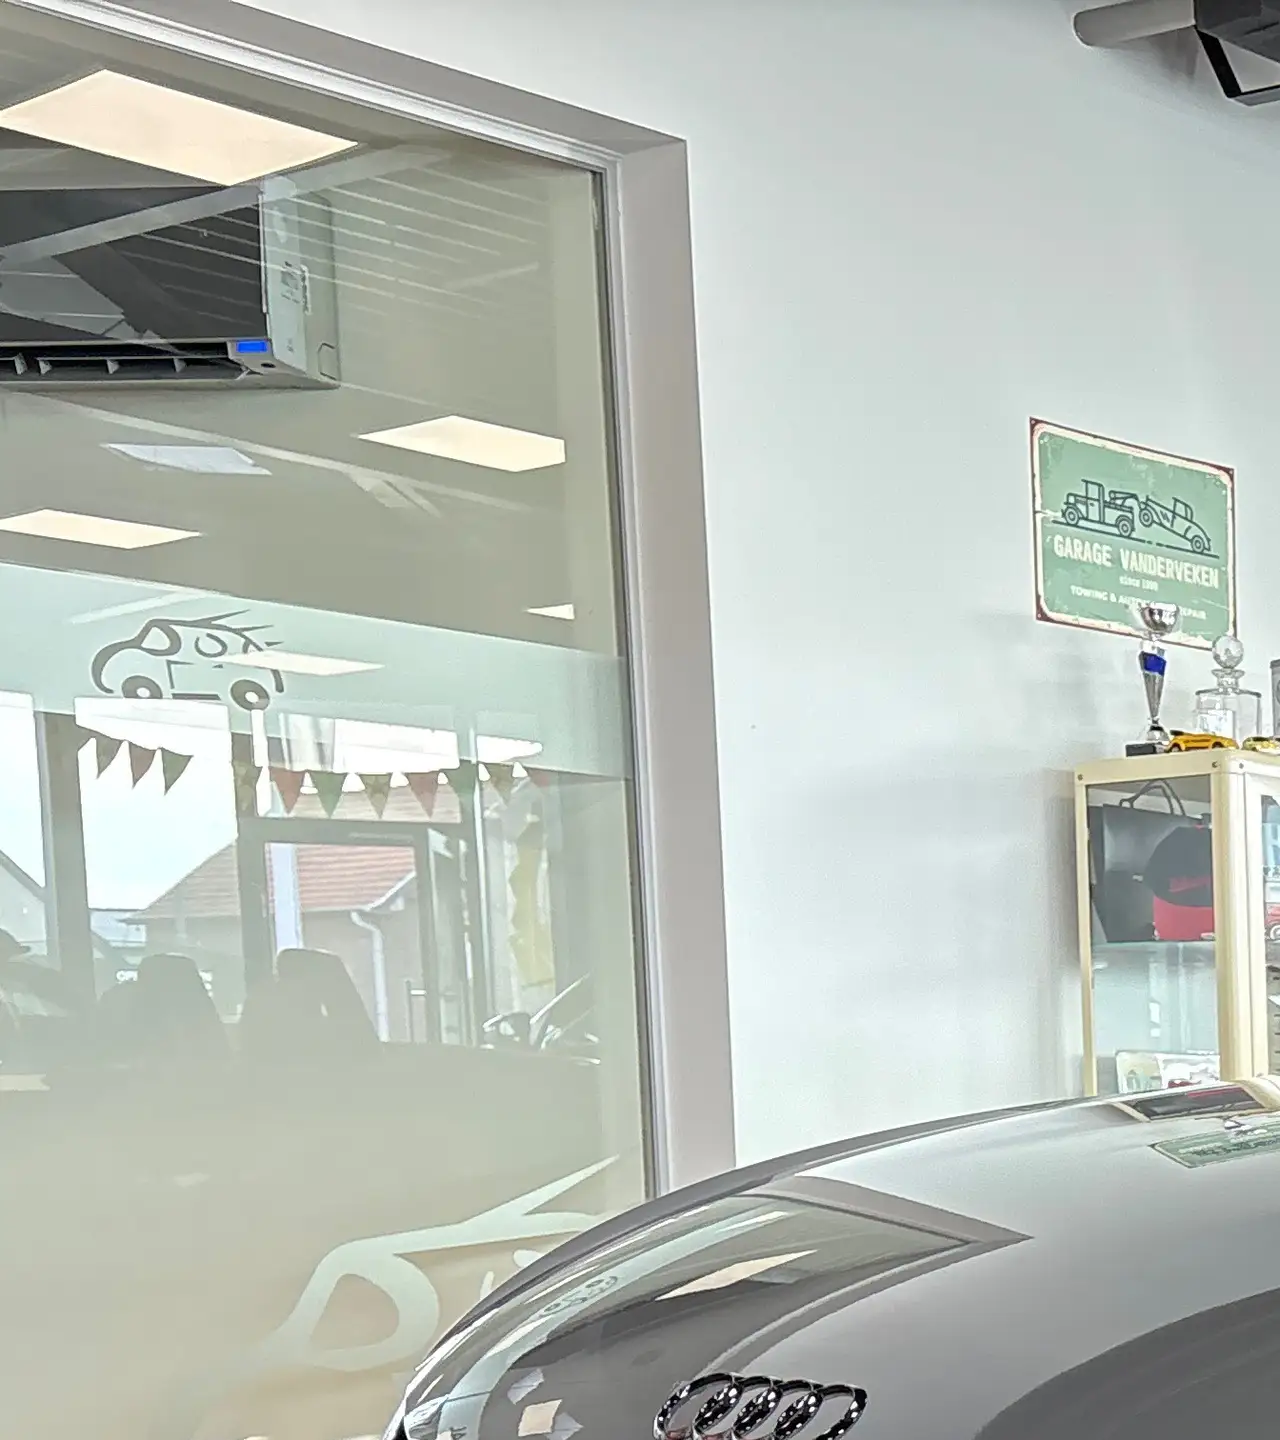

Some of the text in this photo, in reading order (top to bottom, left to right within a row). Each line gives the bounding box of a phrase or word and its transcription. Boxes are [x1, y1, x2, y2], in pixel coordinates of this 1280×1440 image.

[1054, 535, 1219, 589] GARAGE VANDERVEKEN
[1070, 585, 1108, 601] TOWING
